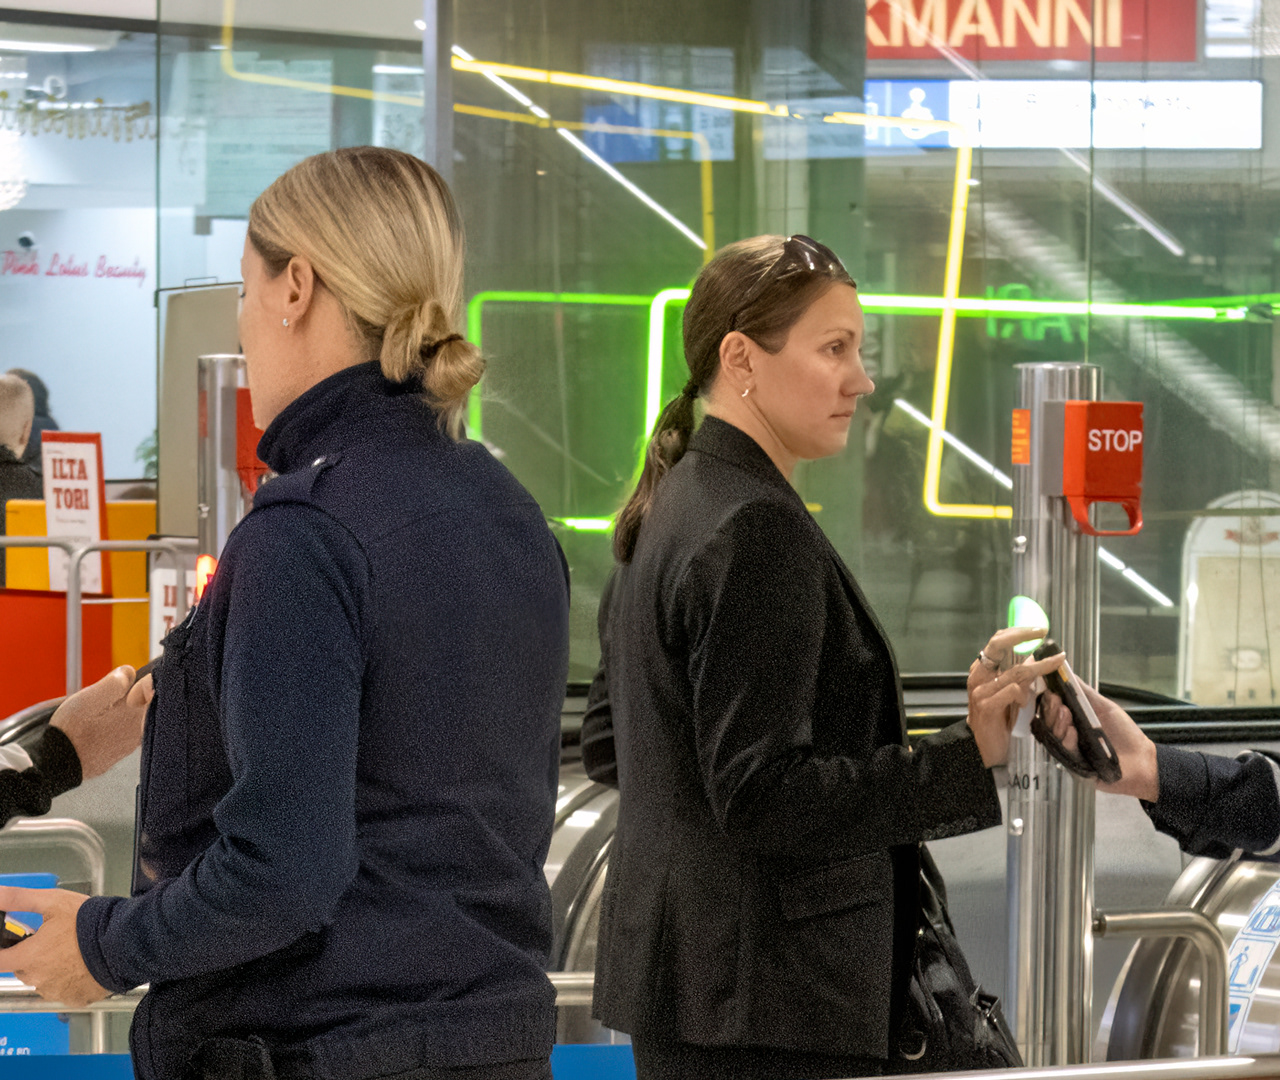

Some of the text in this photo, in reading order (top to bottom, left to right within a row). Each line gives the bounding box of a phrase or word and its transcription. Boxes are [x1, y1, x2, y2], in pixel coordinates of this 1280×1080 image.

[45, 253, 88, 276] Lotus
[95, 255, 145, 287] Beauty
[1088, 429, 1142, 451] STOP
[52, 458, 88, 480] ILTA
[53, 488, 90, 510] TORI
